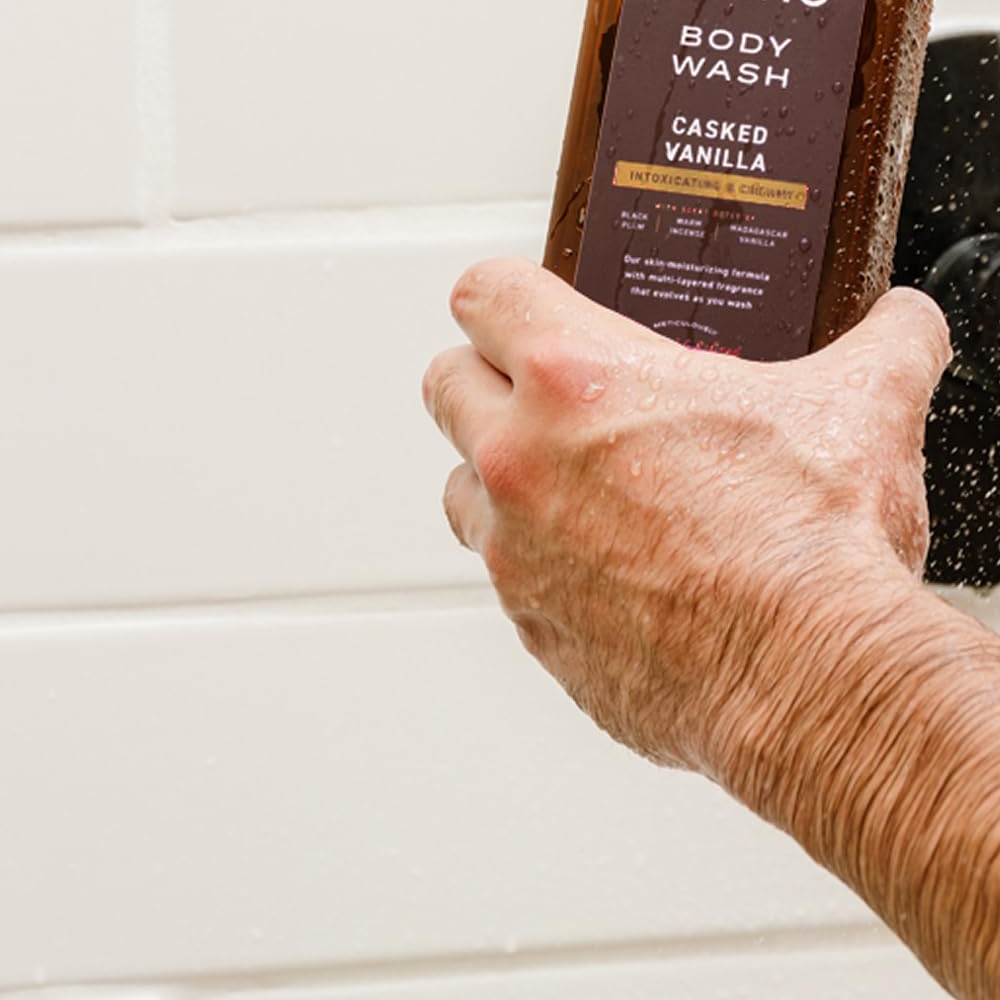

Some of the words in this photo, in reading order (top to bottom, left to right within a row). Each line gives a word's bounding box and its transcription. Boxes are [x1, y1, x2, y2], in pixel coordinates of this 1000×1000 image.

[679, 25, 792, 57] BODY
[671, 54, 790, 88] WASH
[671, 116, 768, 145] CASKED
[664, 142, 766, 172] VANILLA
[629, 170, 721, 192] INTOXICATING
[620, 210, 649, 221] BLACK
[676, 217, 703, 227] WARM
[669, 227, 705, 239] INCENSE
[730, 224, 789, 239] MADAGASCAR
[738, 235, 776, 248] VANILLA
[623, 254, 641, 265] Our
[644, 257, 729, 278] skin-moisturizing
[731, 267, 771, 282] formula
[624, 270, 646, 281] with
[648, 274, 714, 290] multi-layered
[716, 281, 765, 297] fragrance
[630, 285, 651, 297] that
[652, 289, 691, 302] evolves
[692, 295, 704, 304] as
[706, 297, 725, 306] you
[727, 299, 753, 310] wash
